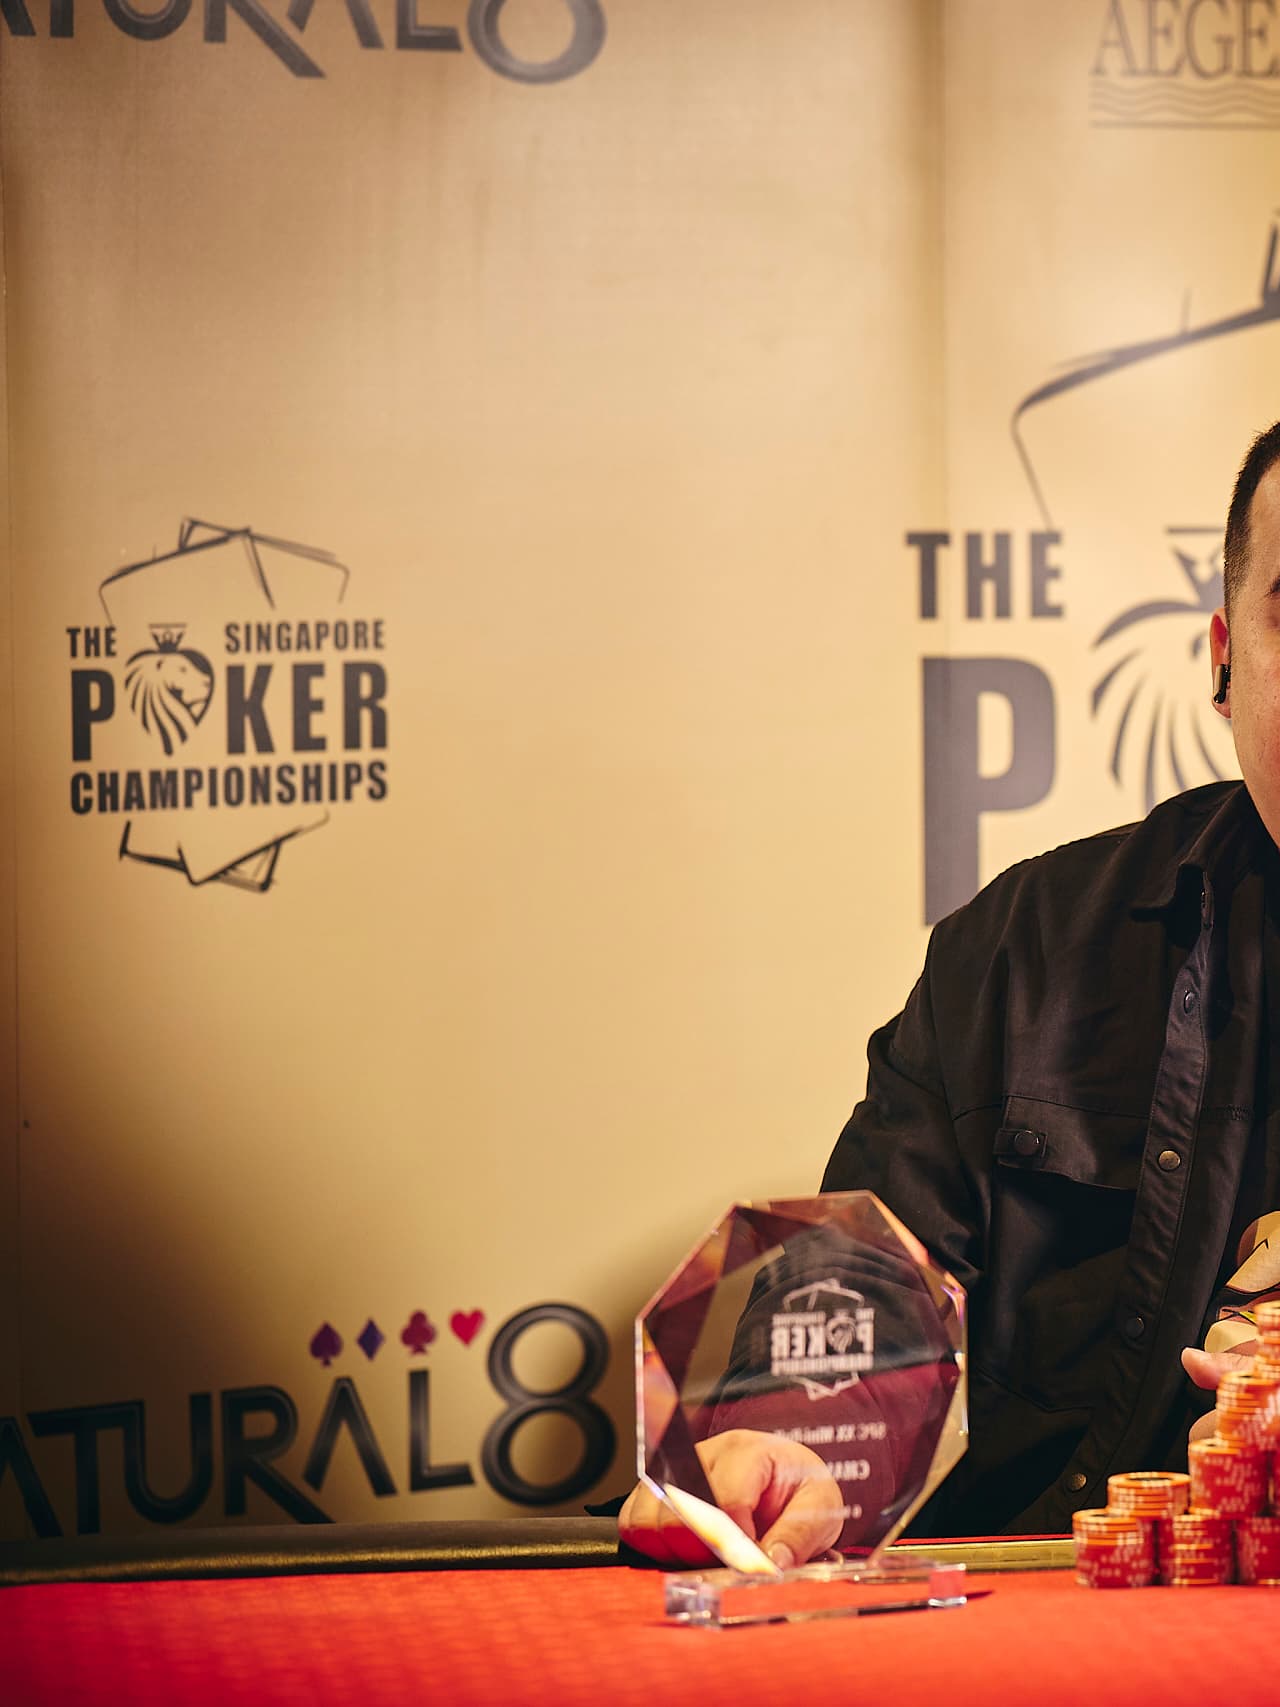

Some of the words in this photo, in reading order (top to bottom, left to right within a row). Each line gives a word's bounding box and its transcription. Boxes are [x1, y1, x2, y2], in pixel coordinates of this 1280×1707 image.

[905, 530, 1065, 621] THE
[66, 626, 117, 659] THE
[224, 618, 386, 655] SINGAPORE
[70, 759, 389, 816] CHAMPIONSHIPS
